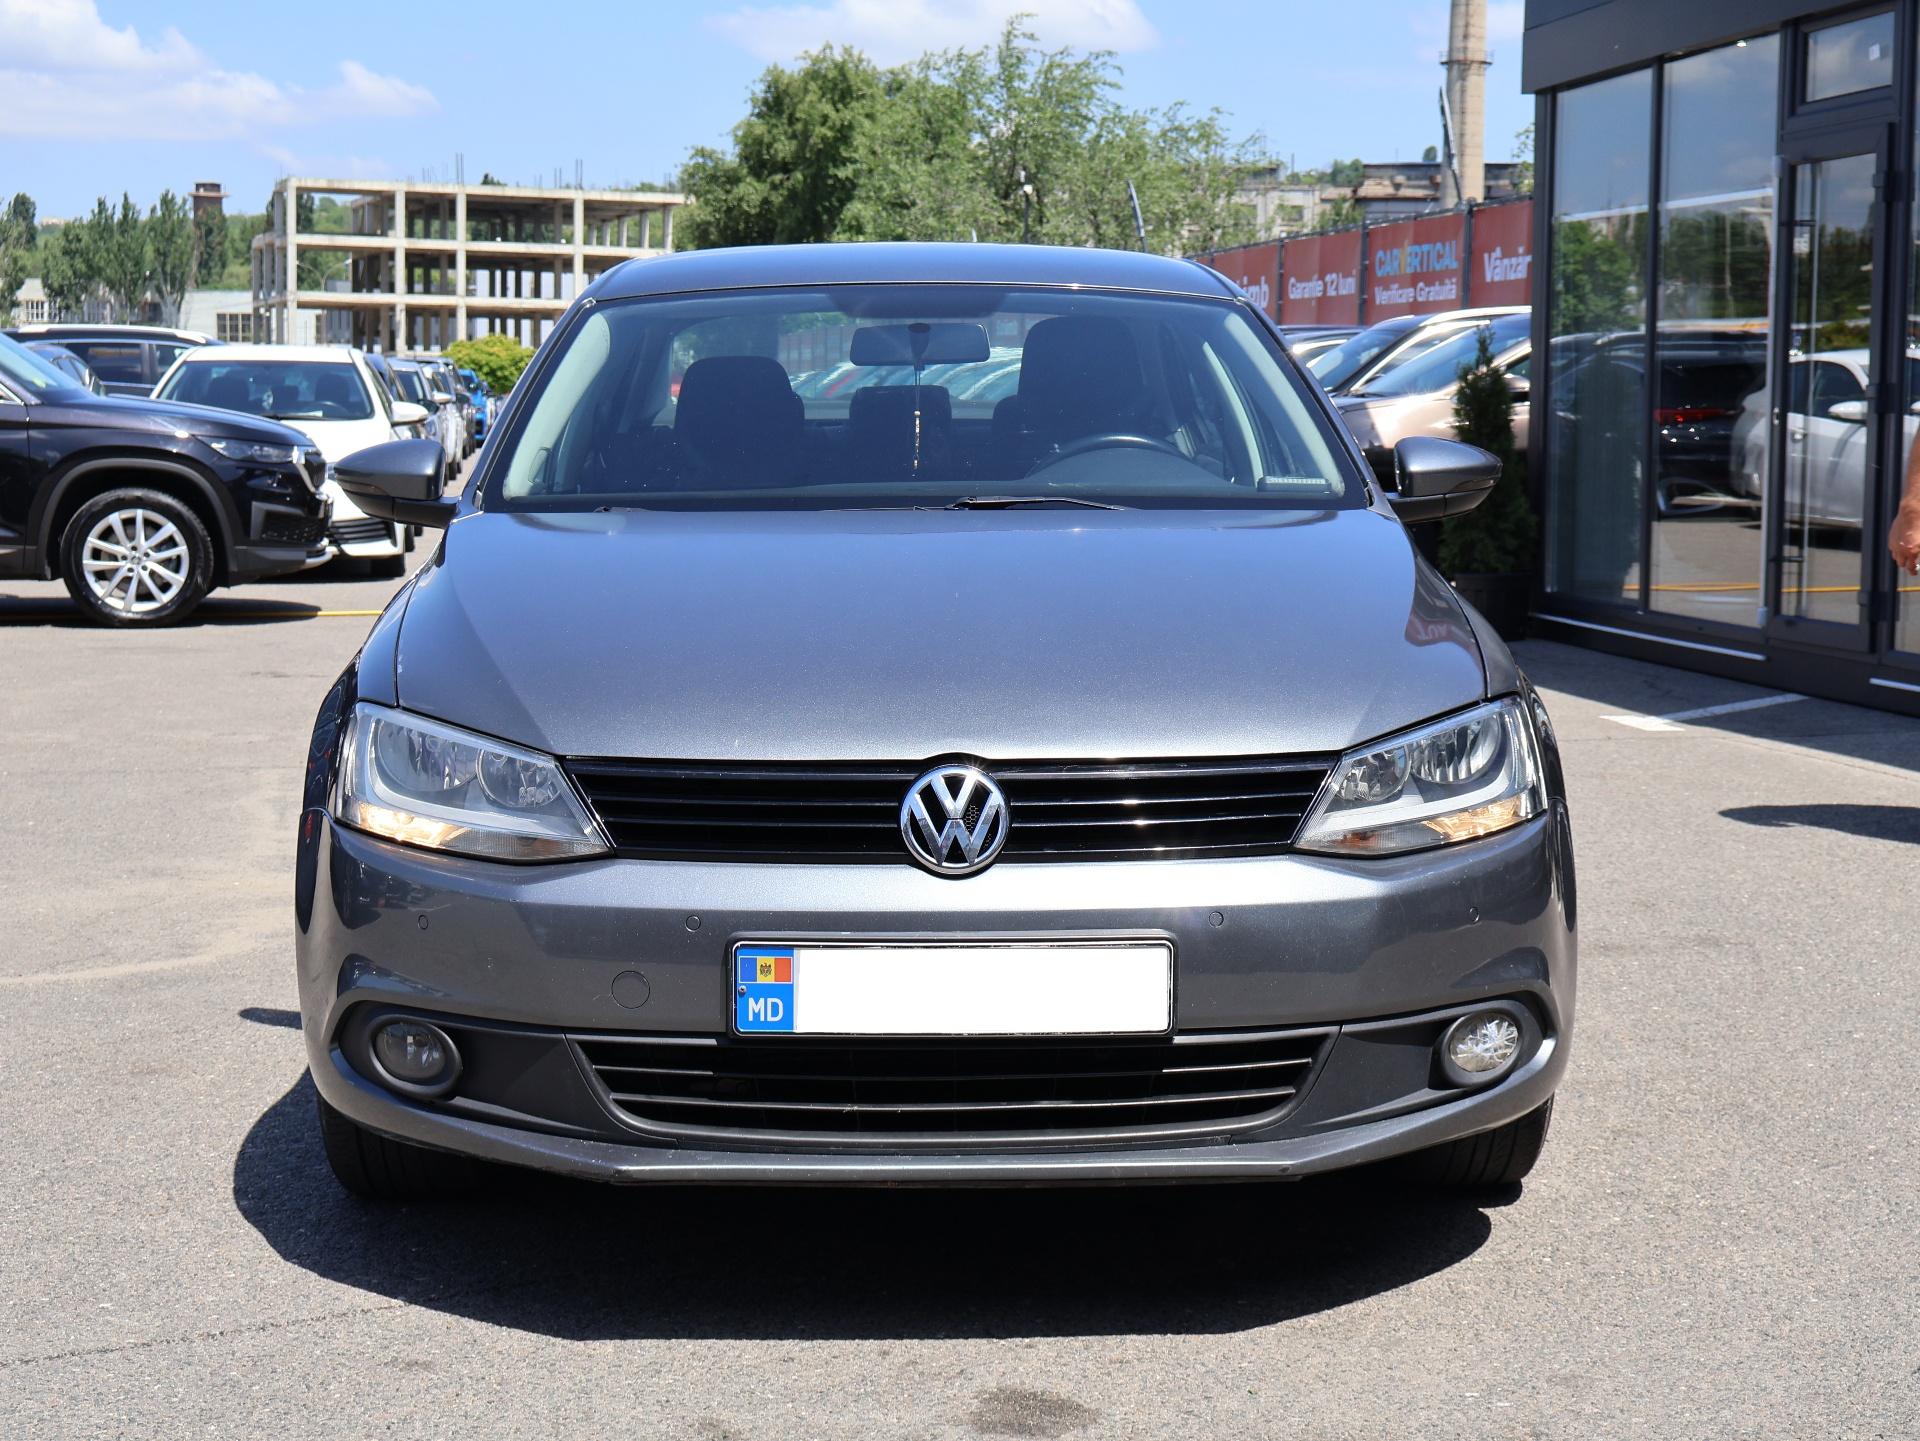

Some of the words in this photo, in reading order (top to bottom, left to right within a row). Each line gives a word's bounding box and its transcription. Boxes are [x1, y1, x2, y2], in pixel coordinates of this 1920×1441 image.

[1375, 240, 1458, 278] CARVERTICAL
[1236, 275, 1270, 308] imb
[1325, 272, 1338, 297] 12
[1338, 268, 1357, 296] luni
[1374, 283, 1415, 305] Verificare
[903, 766, 1007, 872] VW
[748, 997, 784, 1022] MD
